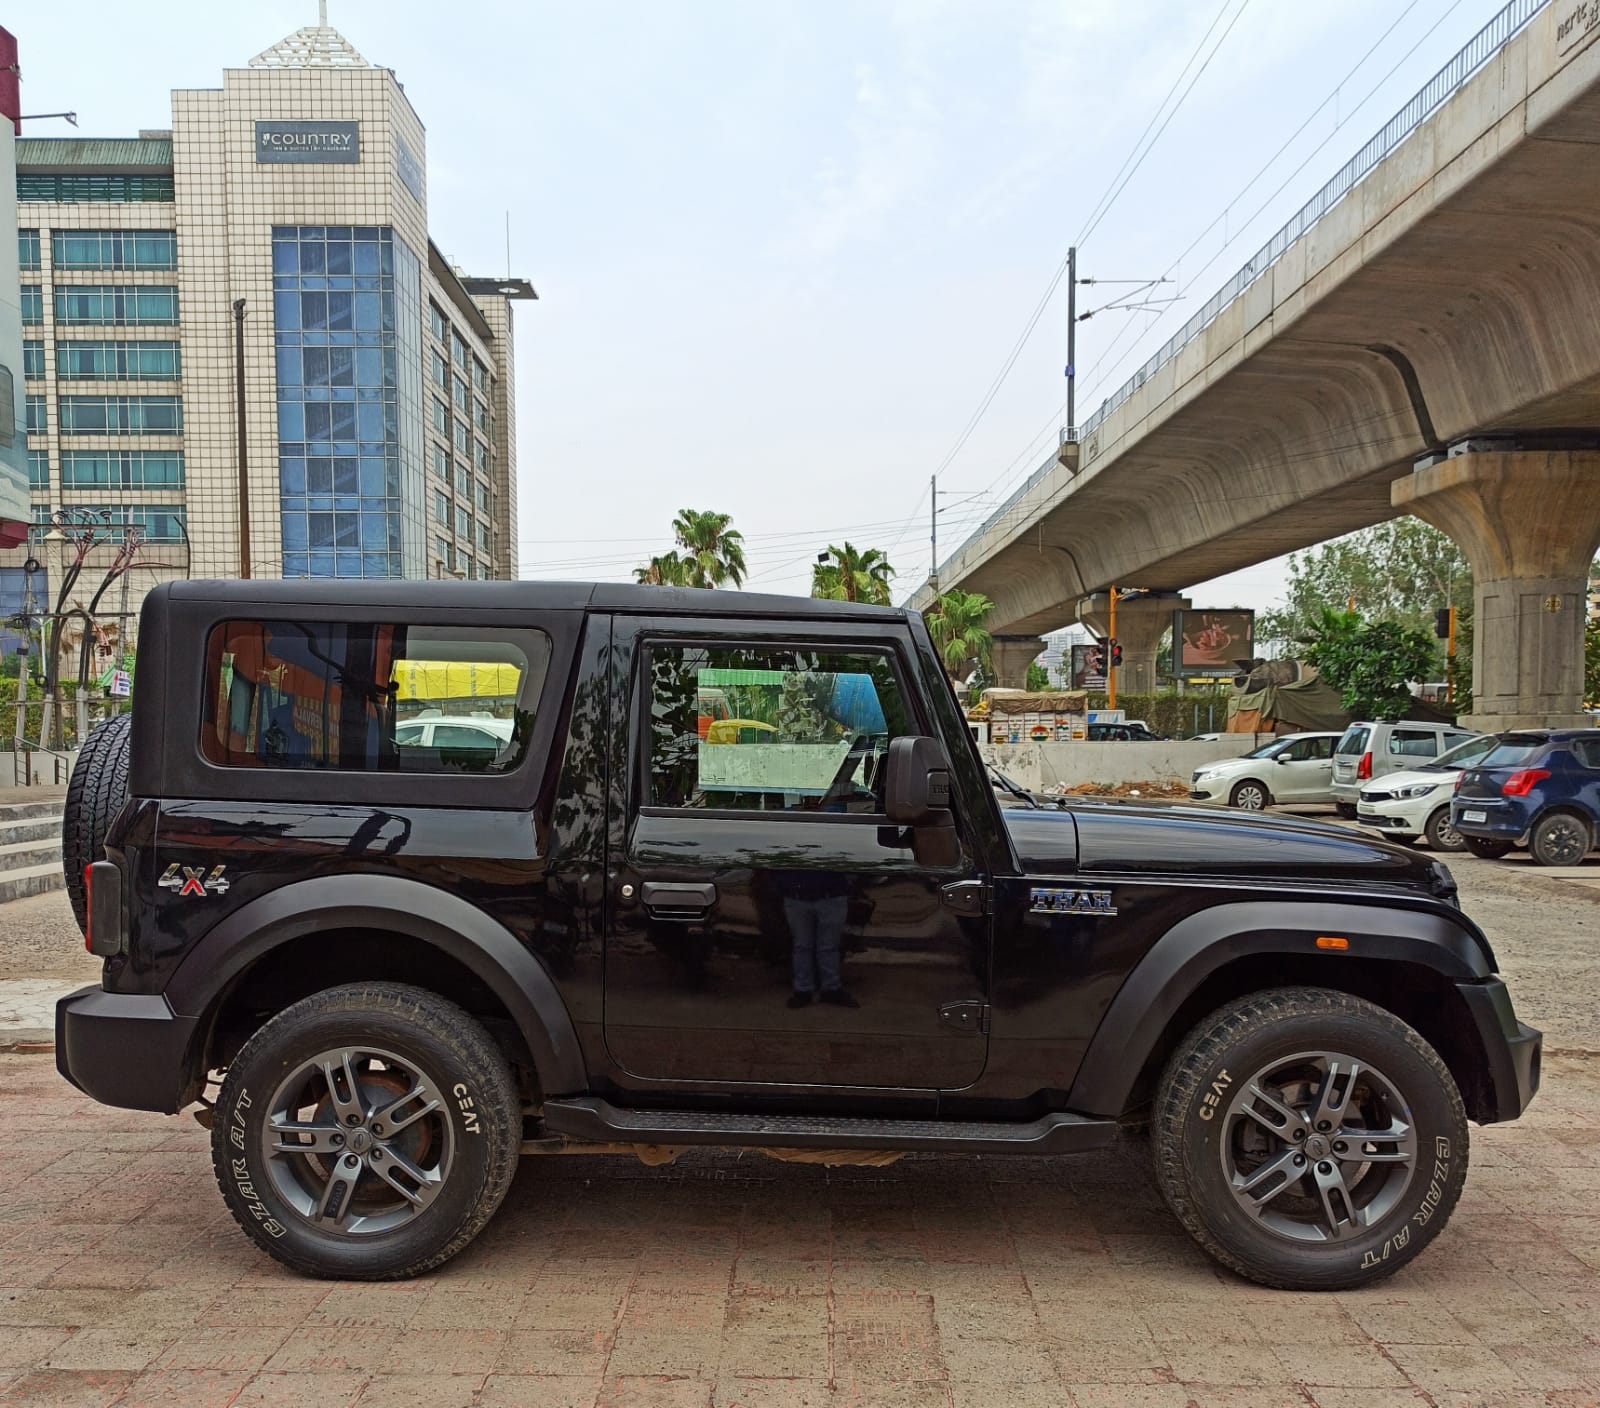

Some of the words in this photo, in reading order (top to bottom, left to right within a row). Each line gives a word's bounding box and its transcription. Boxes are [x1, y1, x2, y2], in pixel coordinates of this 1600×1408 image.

[271, 134, 351, 145] COUNTRY
[1029, 888, 1117, 914] THAR
[230, 1088, 252, 1150] A/T
[453, 1083, 480, 1134] CEAT
[1199, 1068, 1232, 1121] CEAT
[232, 1158, 287, 1238] CZAR
[1413, 1136, 1450, 1226] CZAR
[1361, 1225, 1410, 1269] A/T
